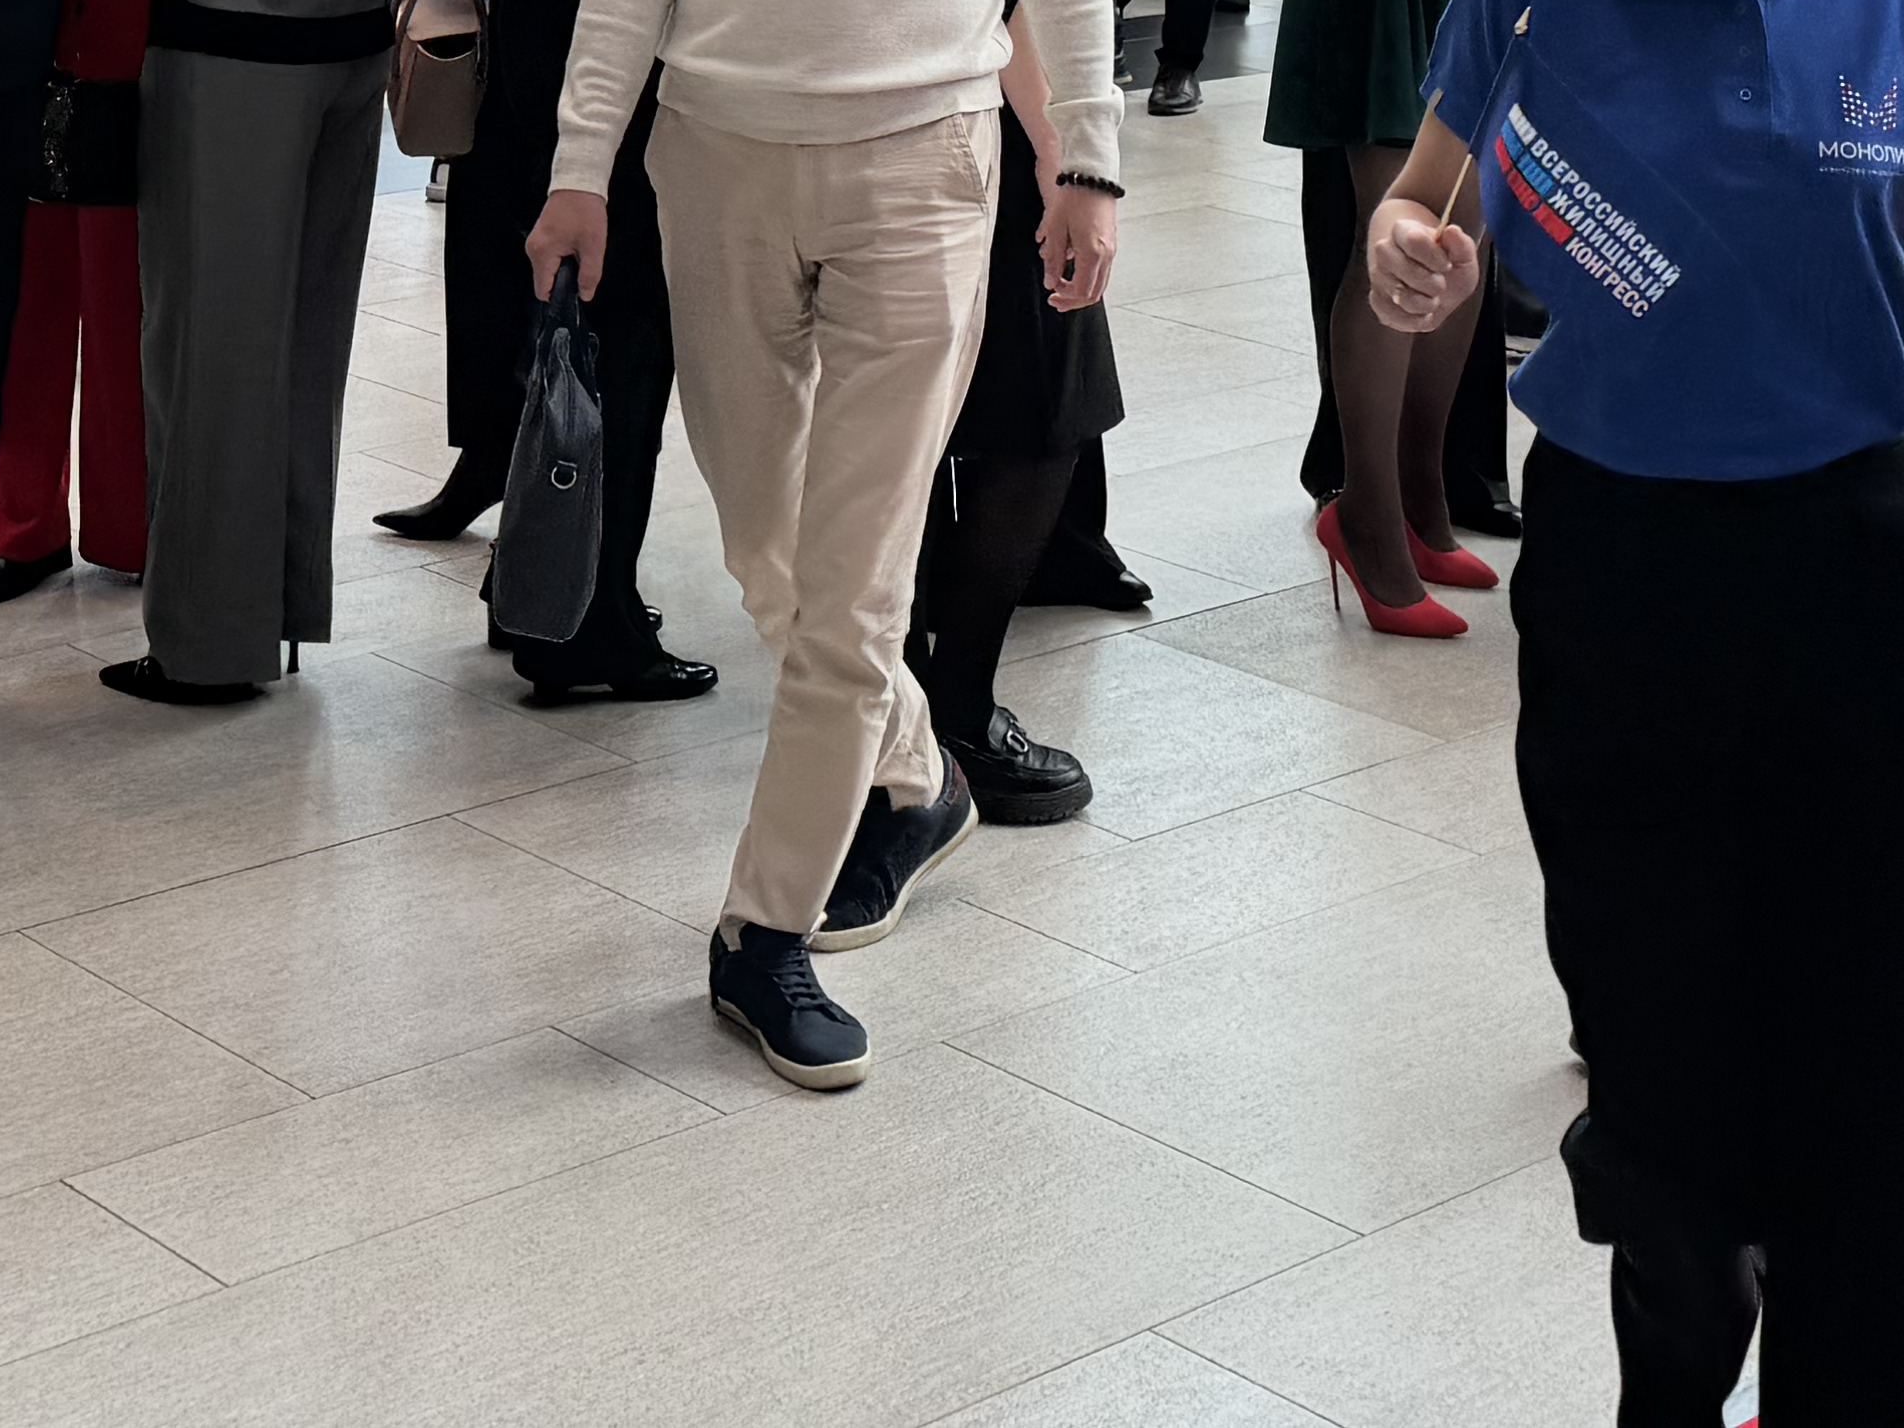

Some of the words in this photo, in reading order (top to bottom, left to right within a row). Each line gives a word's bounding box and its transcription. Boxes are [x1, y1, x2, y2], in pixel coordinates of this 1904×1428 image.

[1529, 137, 1682, 288] ВСЕРОССИЙСКИЙ
[1548, 188, 1666, 304] ЖИЛИЩНЫЙ
[1564, 236, 1649, 319] КОНГРЕСС
